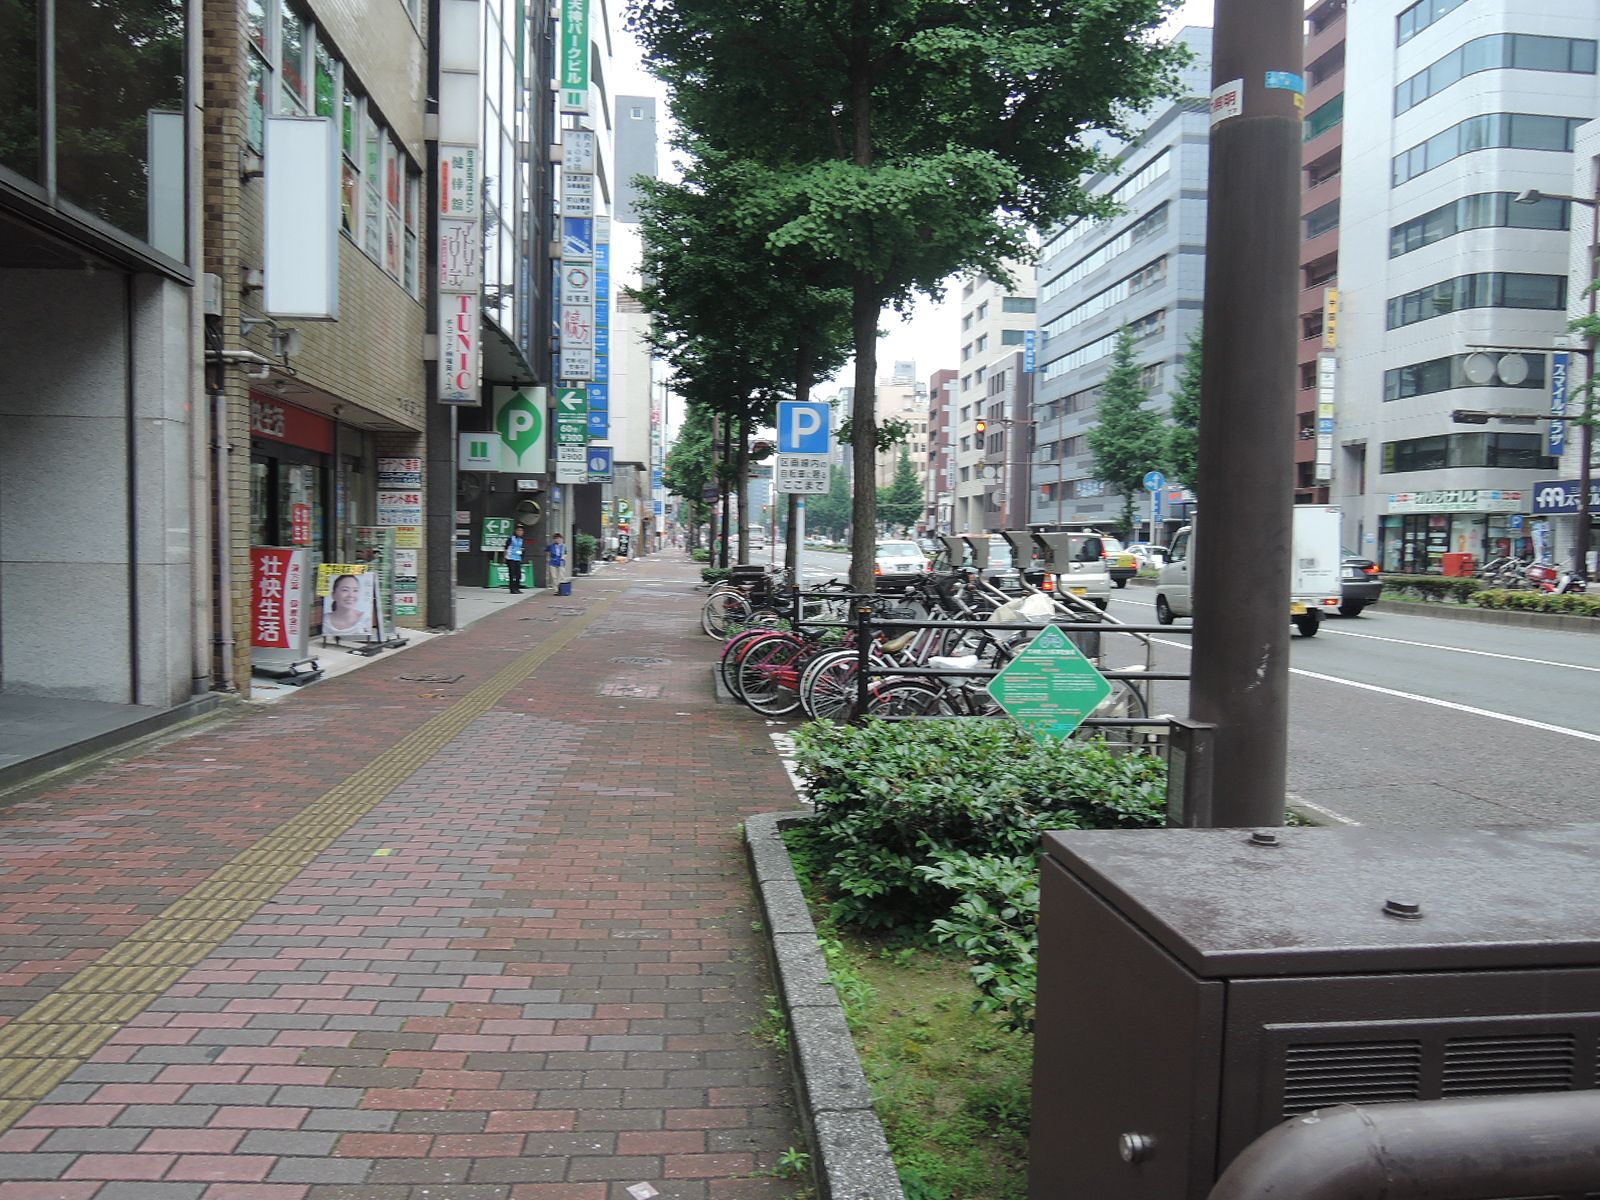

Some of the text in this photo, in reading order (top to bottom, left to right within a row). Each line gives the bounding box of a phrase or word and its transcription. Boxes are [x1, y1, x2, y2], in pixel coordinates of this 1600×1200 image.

[456, 296, 472, 390] TUNIC
[508, 409, 534, 441] P
[791, 407, 821, 448] P
[784, 481, 824, 490] ここまで
[500, 520, 510, 533] P
[258, 556, 283, 642] 壮快生活
